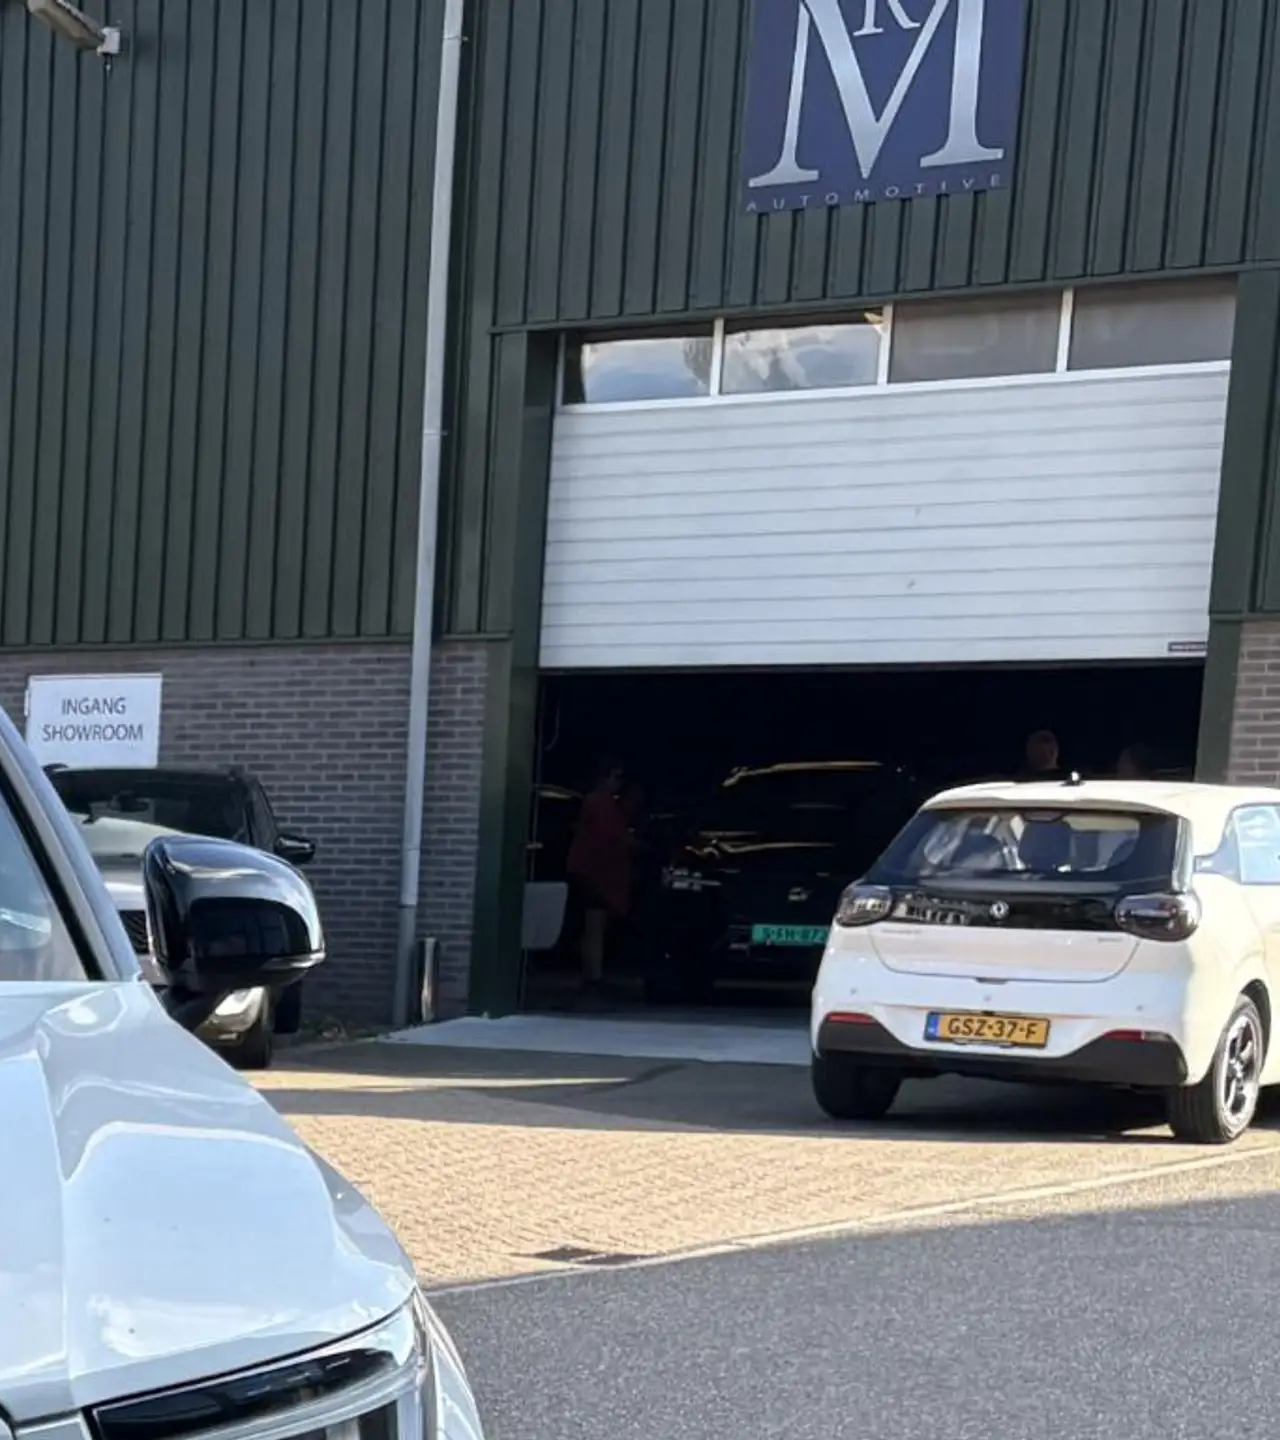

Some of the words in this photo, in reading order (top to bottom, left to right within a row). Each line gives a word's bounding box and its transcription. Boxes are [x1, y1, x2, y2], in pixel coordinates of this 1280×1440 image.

[746, 174, 1007, 212] AUTOMOTIVE
[61, 697, 127, 716] INGANG
[42, 723, 144, 742] SHOWROOM
[947, 1017, 1039, 1040] GSZ-37-F
